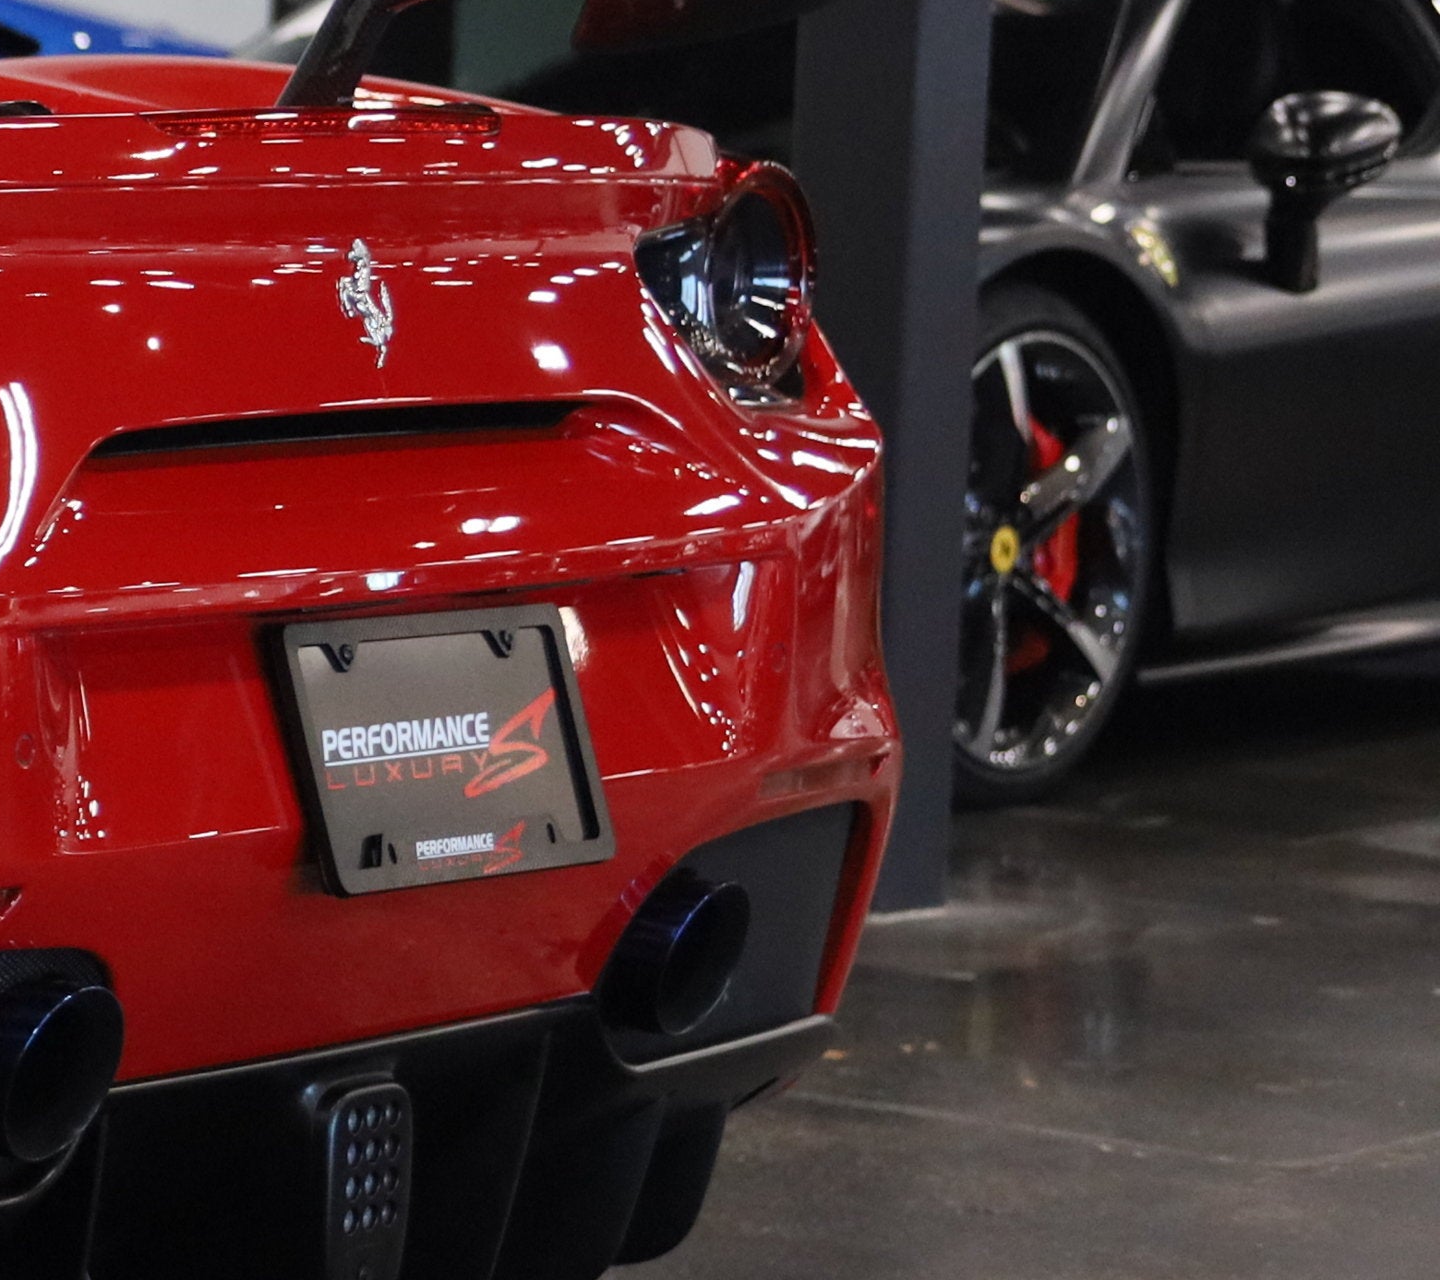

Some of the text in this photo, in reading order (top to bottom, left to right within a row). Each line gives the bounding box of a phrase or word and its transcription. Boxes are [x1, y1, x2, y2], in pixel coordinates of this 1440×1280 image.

[322, 712, 490, 762] PERFORMANCE
[325, 750, 490, 790] LUXURY
[415, 832, 494, 857] PERFORMANCE
